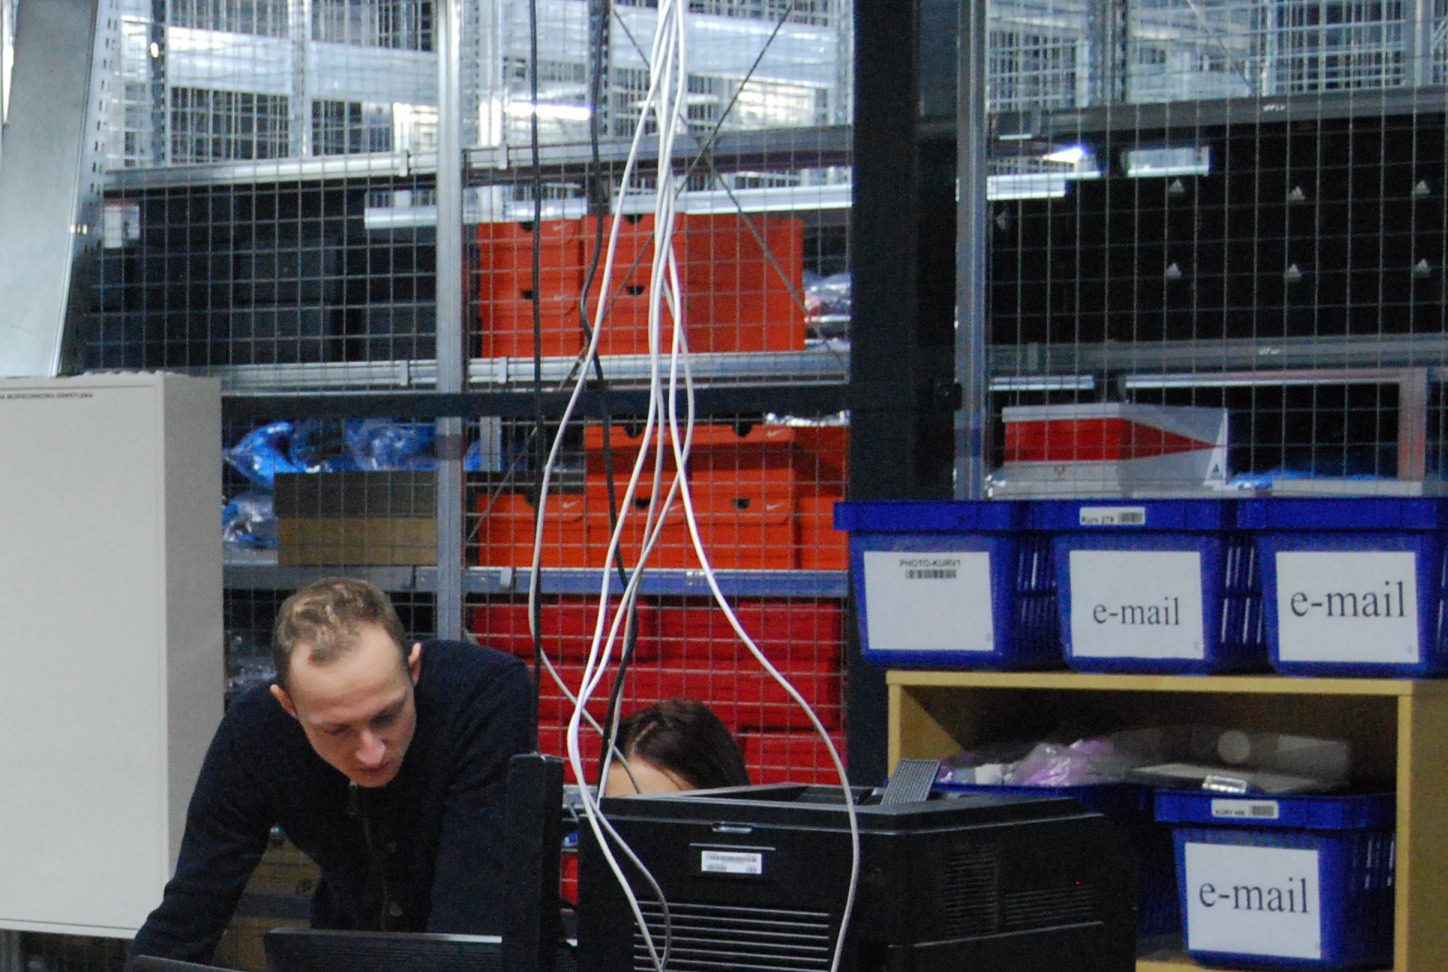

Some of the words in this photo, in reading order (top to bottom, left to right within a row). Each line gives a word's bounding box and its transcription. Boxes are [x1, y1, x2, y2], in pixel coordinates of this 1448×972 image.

[1093, 597, 1181, 627] e-mail
[1290, 581, 1407, 619] e-mail
[1198, 877, 1309, 914] e-mail
